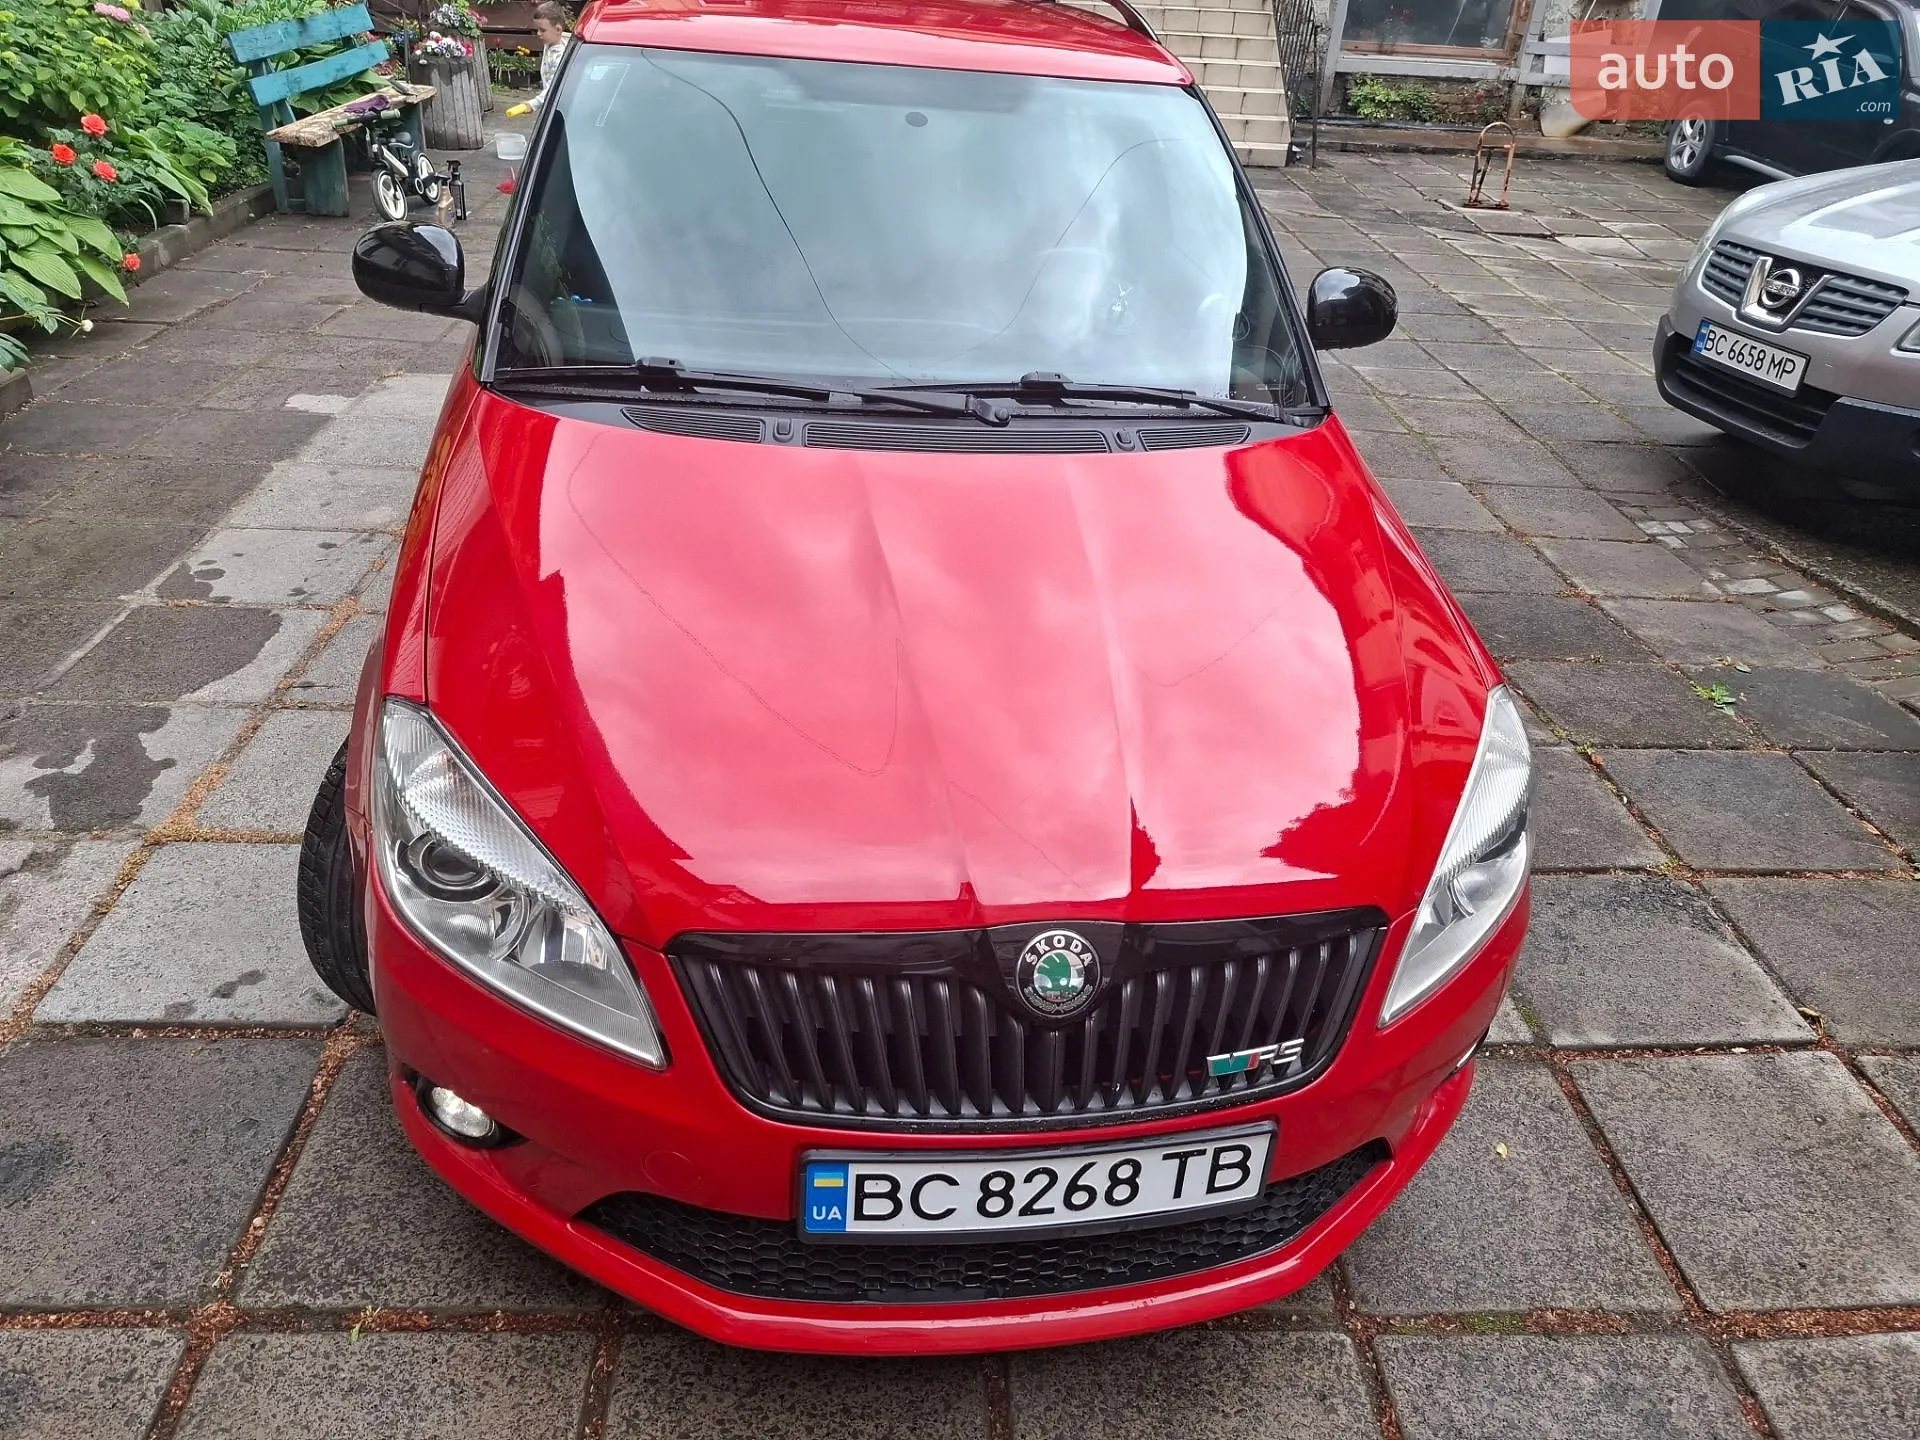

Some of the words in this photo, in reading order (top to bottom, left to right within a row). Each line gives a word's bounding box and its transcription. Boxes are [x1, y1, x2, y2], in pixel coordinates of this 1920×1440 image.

[1704, 329, 1727, 356] BC
[1727, 340, 1767, 371] 6658
[1766, 353, 1796, 379] MP
[853, 1171, 961, 1222] BC
[976, 1157, 1143, 1218] 8268
[1161, 1144, 1252, 1200] TB
[812, 1204, 843, 1221] UA
